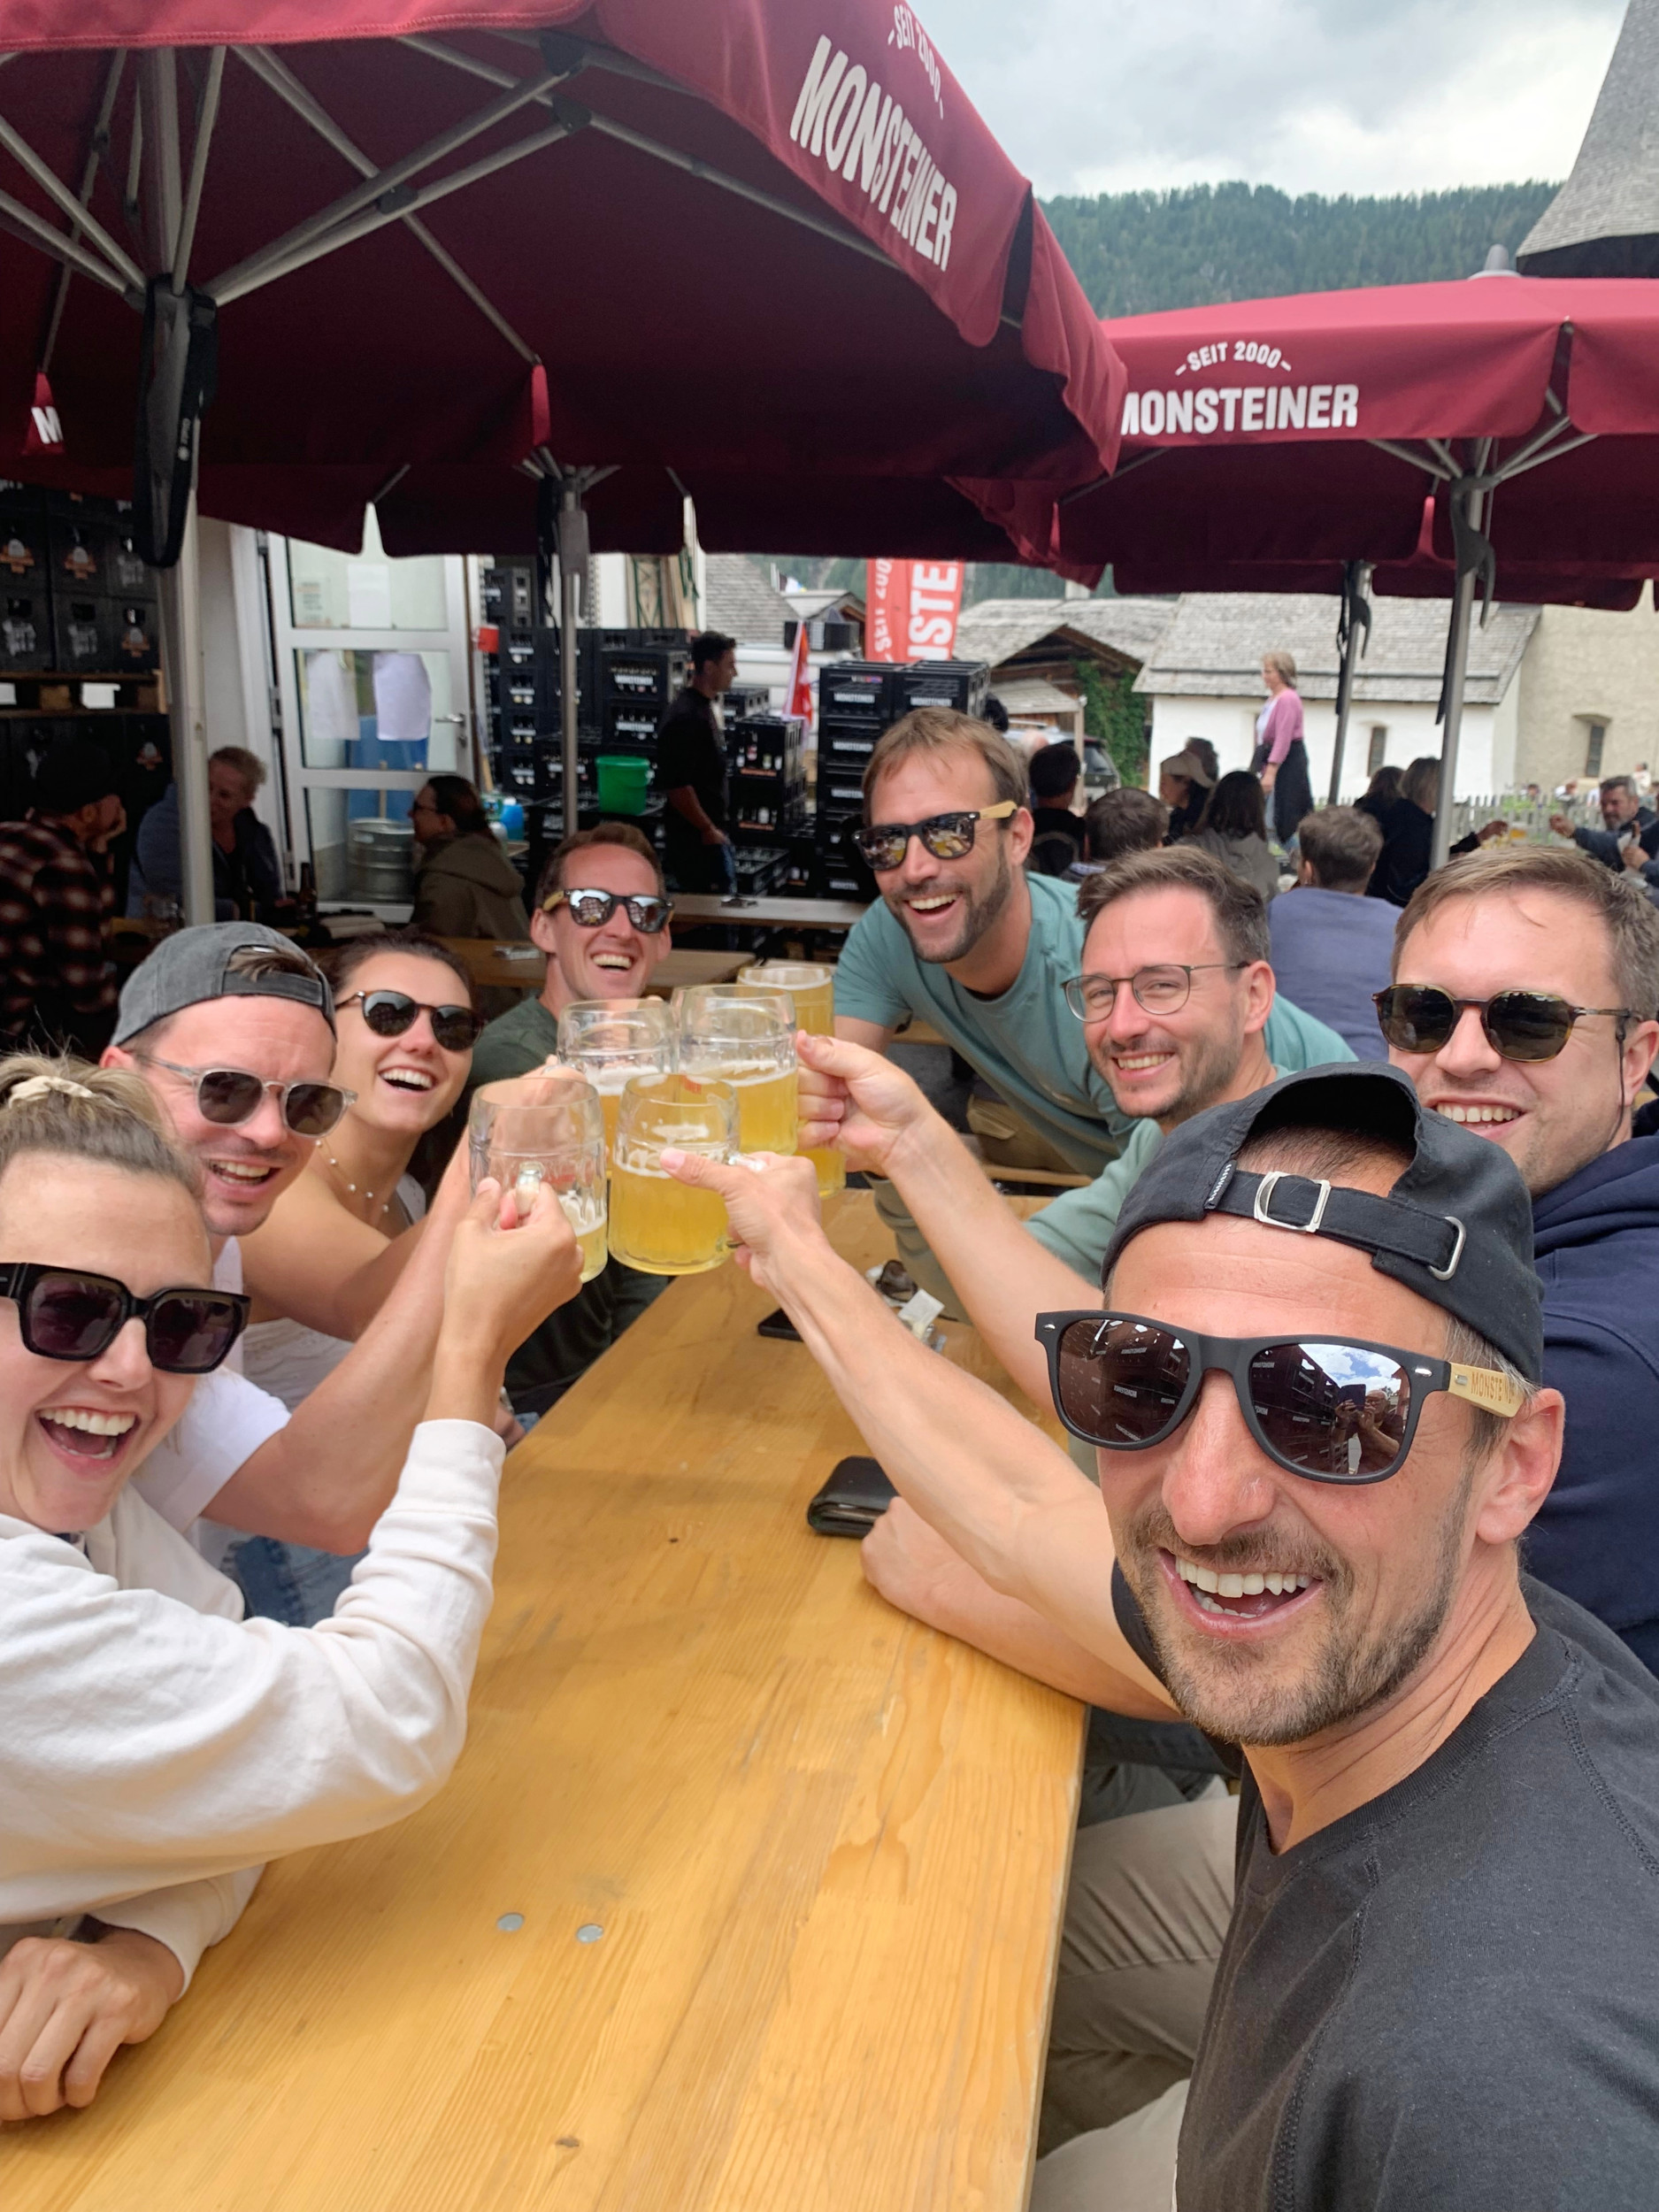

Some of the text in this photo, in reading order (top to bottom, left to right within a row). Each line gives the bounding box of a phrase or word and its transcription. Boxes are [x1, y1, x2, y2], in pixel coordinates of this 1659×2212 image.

[790, 34, 957, 273] MONSTEINER
[1187, 340, 1282, 372] SEIT 2000
